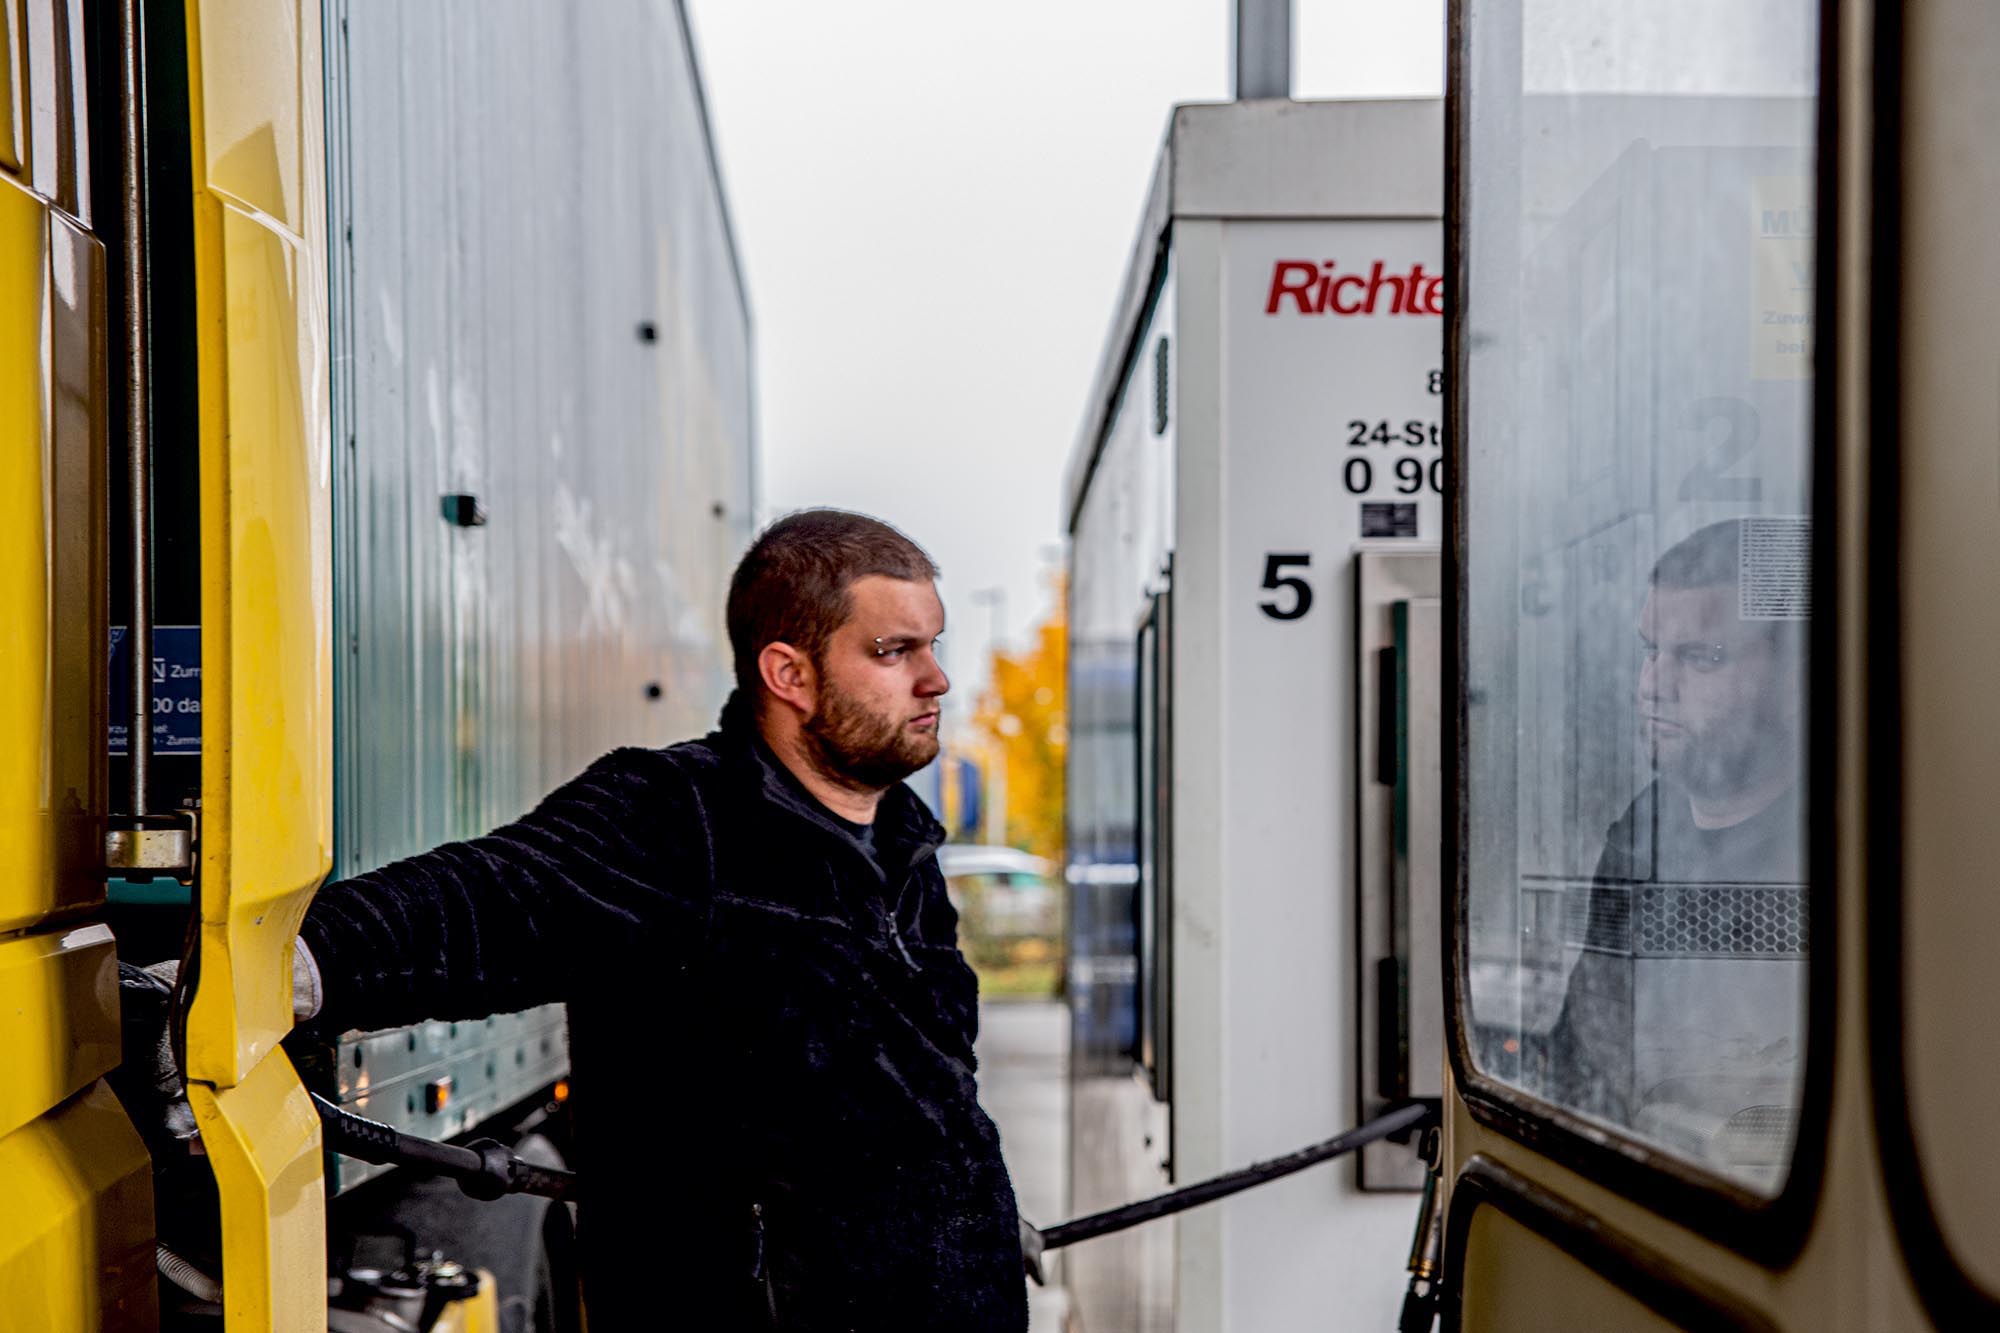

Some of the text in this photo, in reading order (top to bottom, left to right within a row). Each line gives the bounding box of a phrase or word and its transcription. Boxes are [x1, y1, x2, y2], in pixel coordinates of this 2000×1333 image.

[1265, 260, 1443, 316] Richte
[1347, 421, 1440, 446] 24-St
[1677, 396, 1764, 502] 2
[1344, 458, 1372, 494] 0
[1259, 553, 1313, 620] 5
